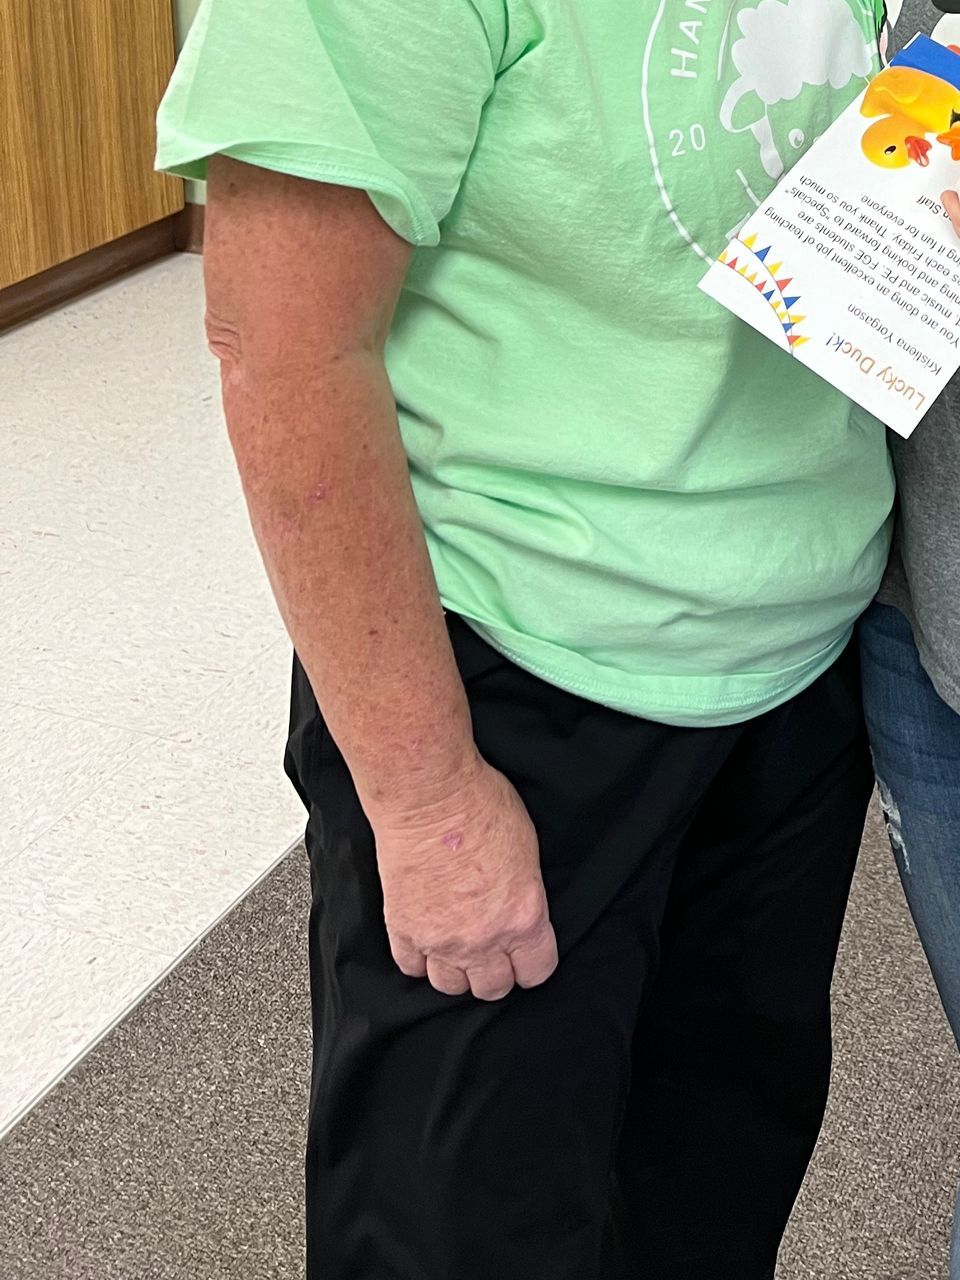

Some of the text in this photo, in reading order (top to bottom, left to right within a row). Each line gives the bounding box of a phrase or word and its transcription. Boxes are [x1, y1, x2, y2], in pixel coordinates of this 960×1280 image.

[799, 176, 827, 196] much
[826, 193, 840, 204] so
[839, 201, 861, 217] you
[916, 195, 945, 216] Staff
[797, 211, 816, 226] are
[834, 216, 846, 228] to
[859, 214, 888, 239] Thank
[815, 223, 856, 253] students
[843, 223, 882, 253] forward
[904, 225, 921, 239] for
[920, 234, 938, 251] fun
[854, 249, 880, 272] FGE
[937, 245, 947, 255] it
[881, 245, 919, 277] looking
[925, 256, 951, 277] each
[764, 207, 960, 350] You are doing an excellent job of teaching
[898, 279, 922, 297] and
[916, 271, 940, 289] and
[921, 294, 953, 320] music
[847, 304, 895, 344] Yorgason
[825, 333, 926, 411] Lucky Duck!
